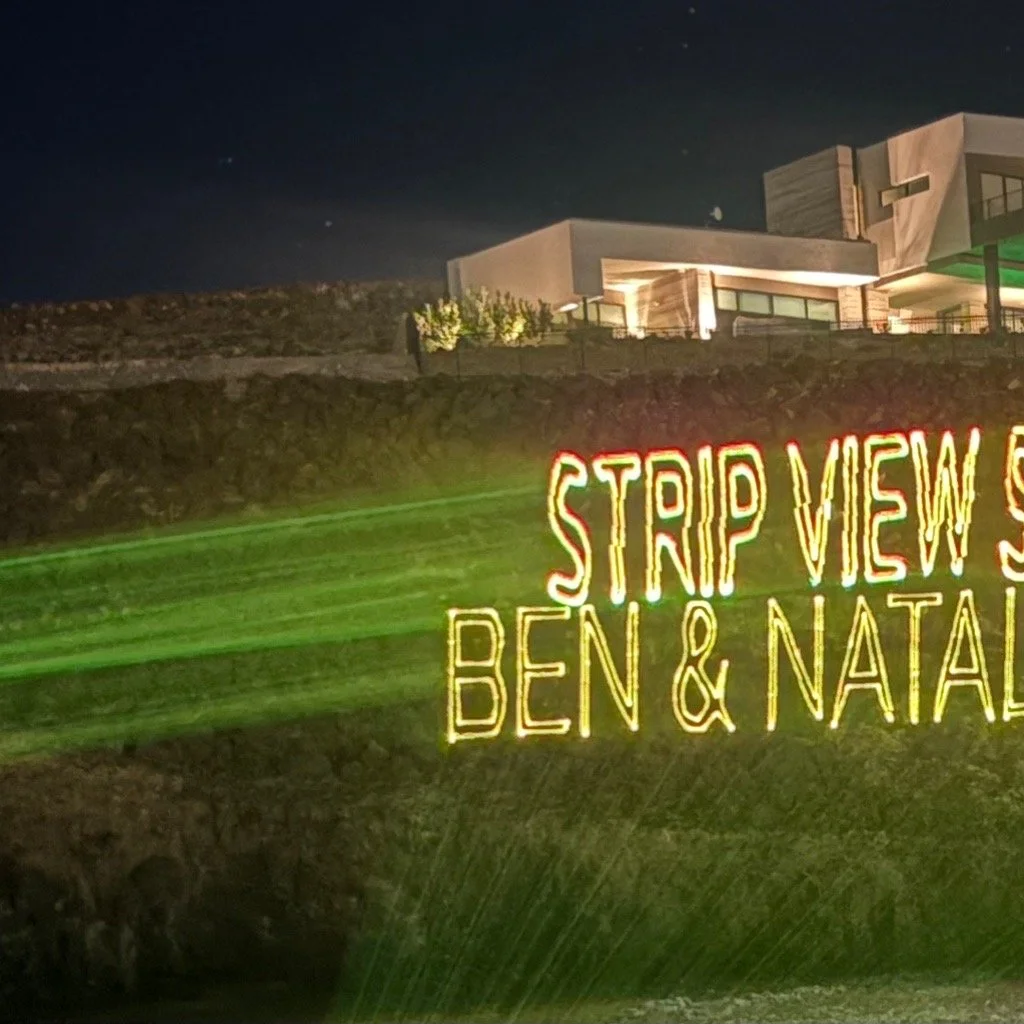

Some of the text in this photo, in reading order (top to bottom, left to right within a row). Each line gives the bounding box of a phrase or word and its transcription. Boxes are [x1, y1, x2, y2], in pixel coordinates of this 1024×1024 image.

[547, 446, 767, 606] STRIP
[787, 426, 981, 588] VIEW
[446, 601, 640, 745] BEN
[671, 599, 737, 735] &
